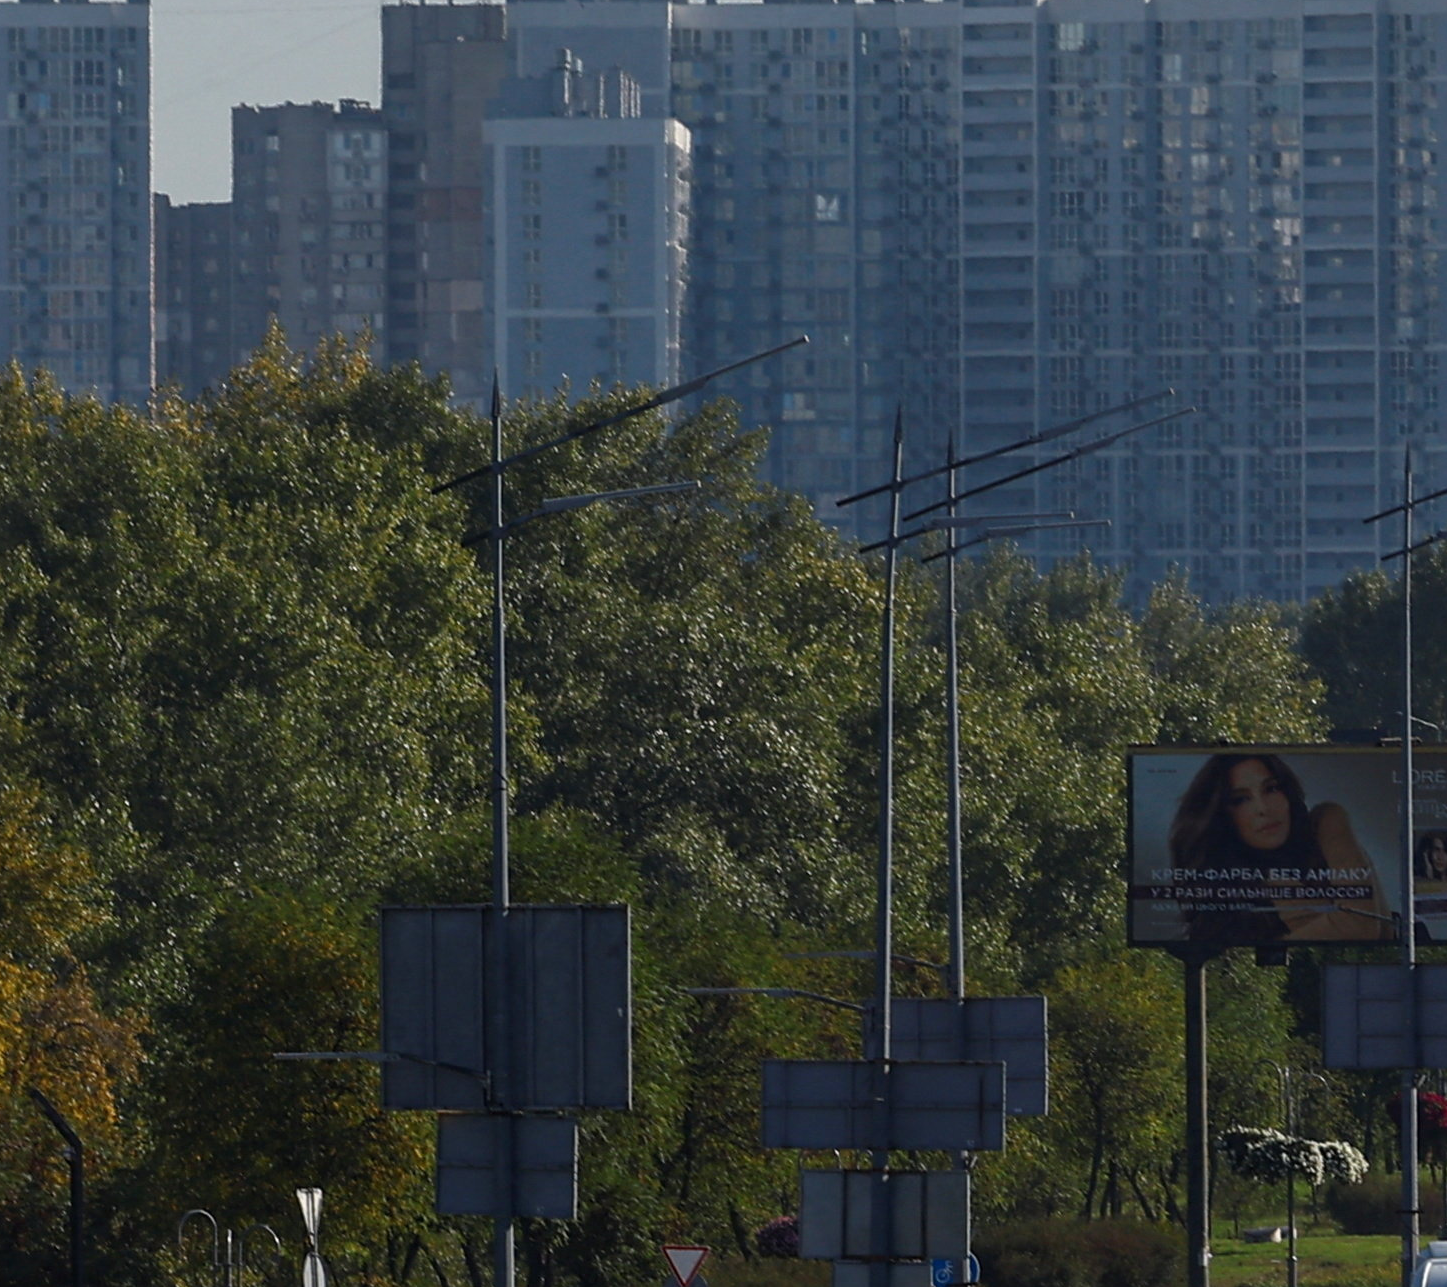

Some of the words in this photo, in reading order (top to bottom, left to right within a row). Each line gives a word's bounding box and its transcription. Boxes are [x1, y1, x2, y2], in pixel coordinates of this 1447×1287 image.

[1151, 867, 1264, 882] КРЕМ-ФАРБА
[1268, 867, 1302, 882] БЕЗ
[1304, 867, 1372, 882] АМІАКУ
[1164, 887, 1172, 899] 2
[1175, 887, 1213, 899] РАЗИ
[1217, 887, 1293, 899] СИЛЬНІШЕ
